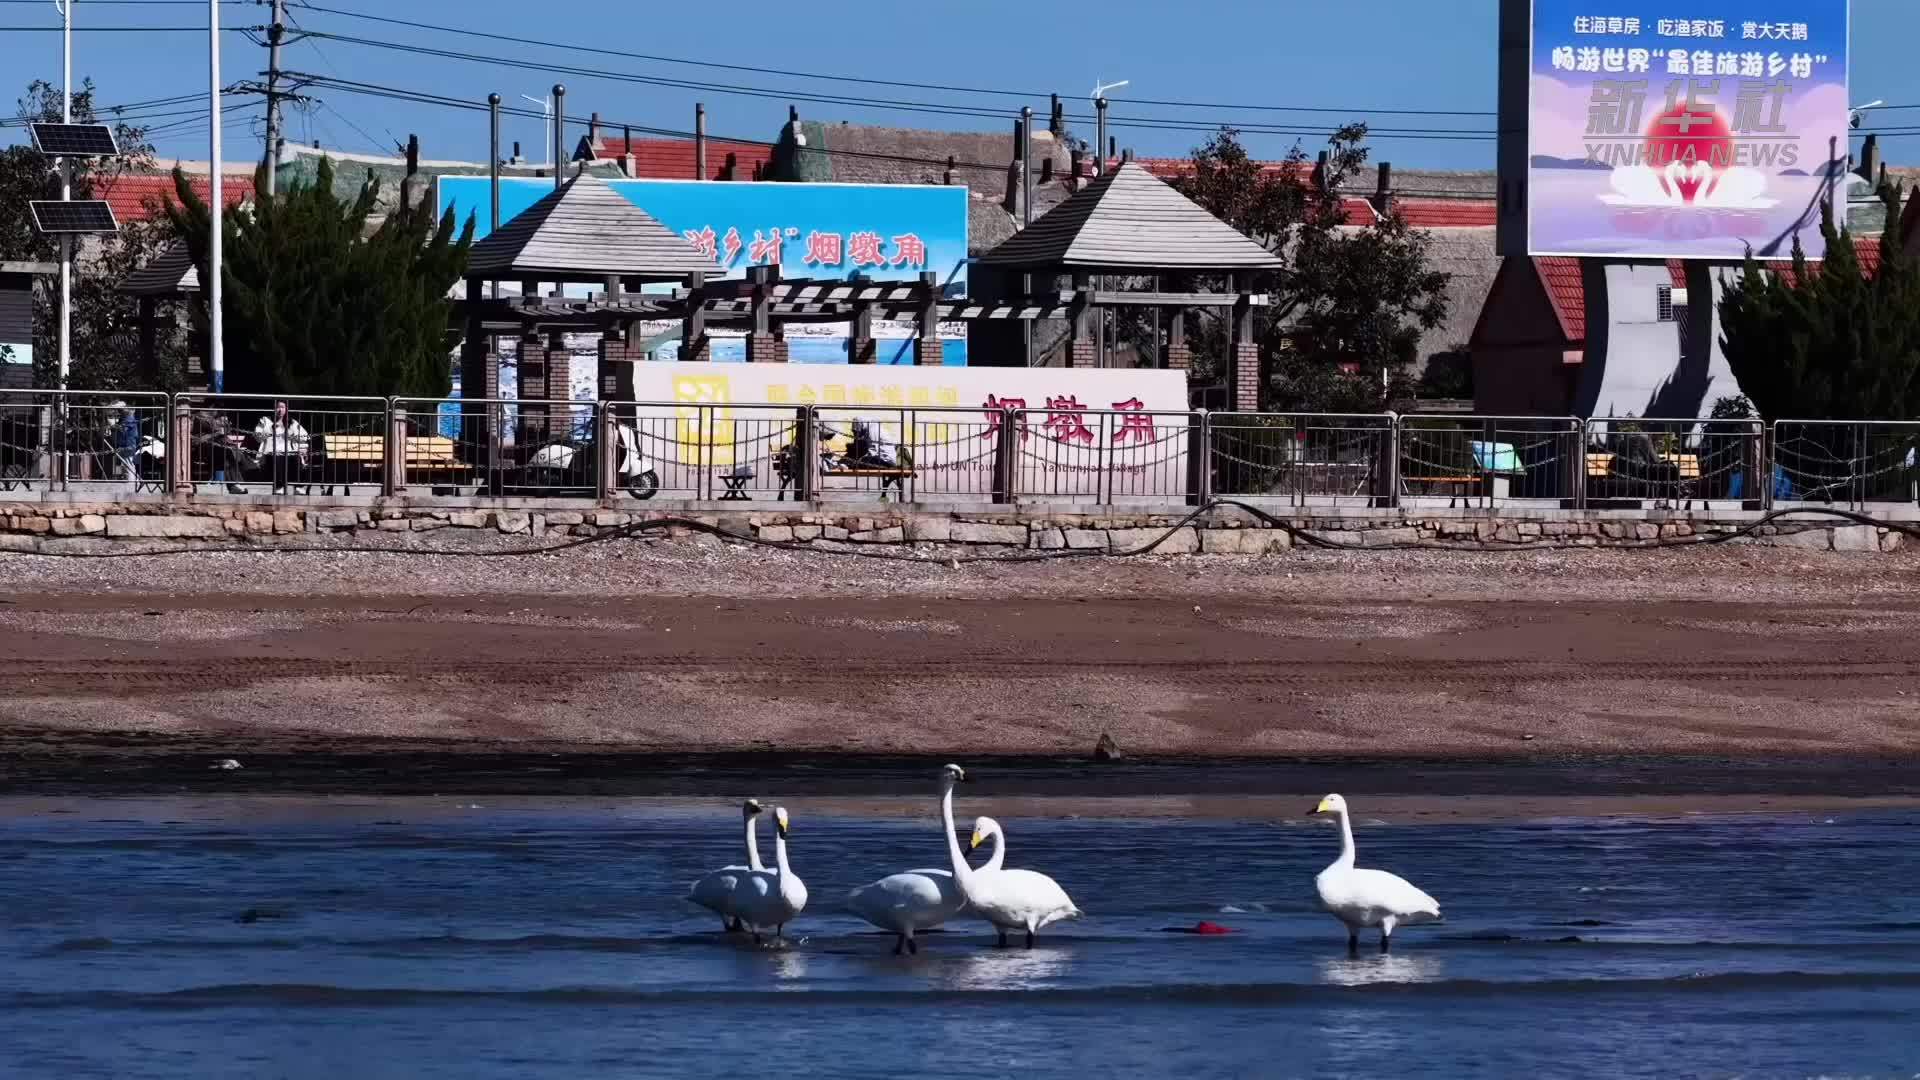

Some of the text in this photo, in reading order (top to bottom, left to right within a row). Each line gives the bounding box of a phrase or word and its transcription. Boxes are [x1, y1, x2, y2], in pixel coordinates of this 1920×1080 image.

[1573, 15, 1809, 41] 住海草房 吃渔家饭 赏大天鹅
